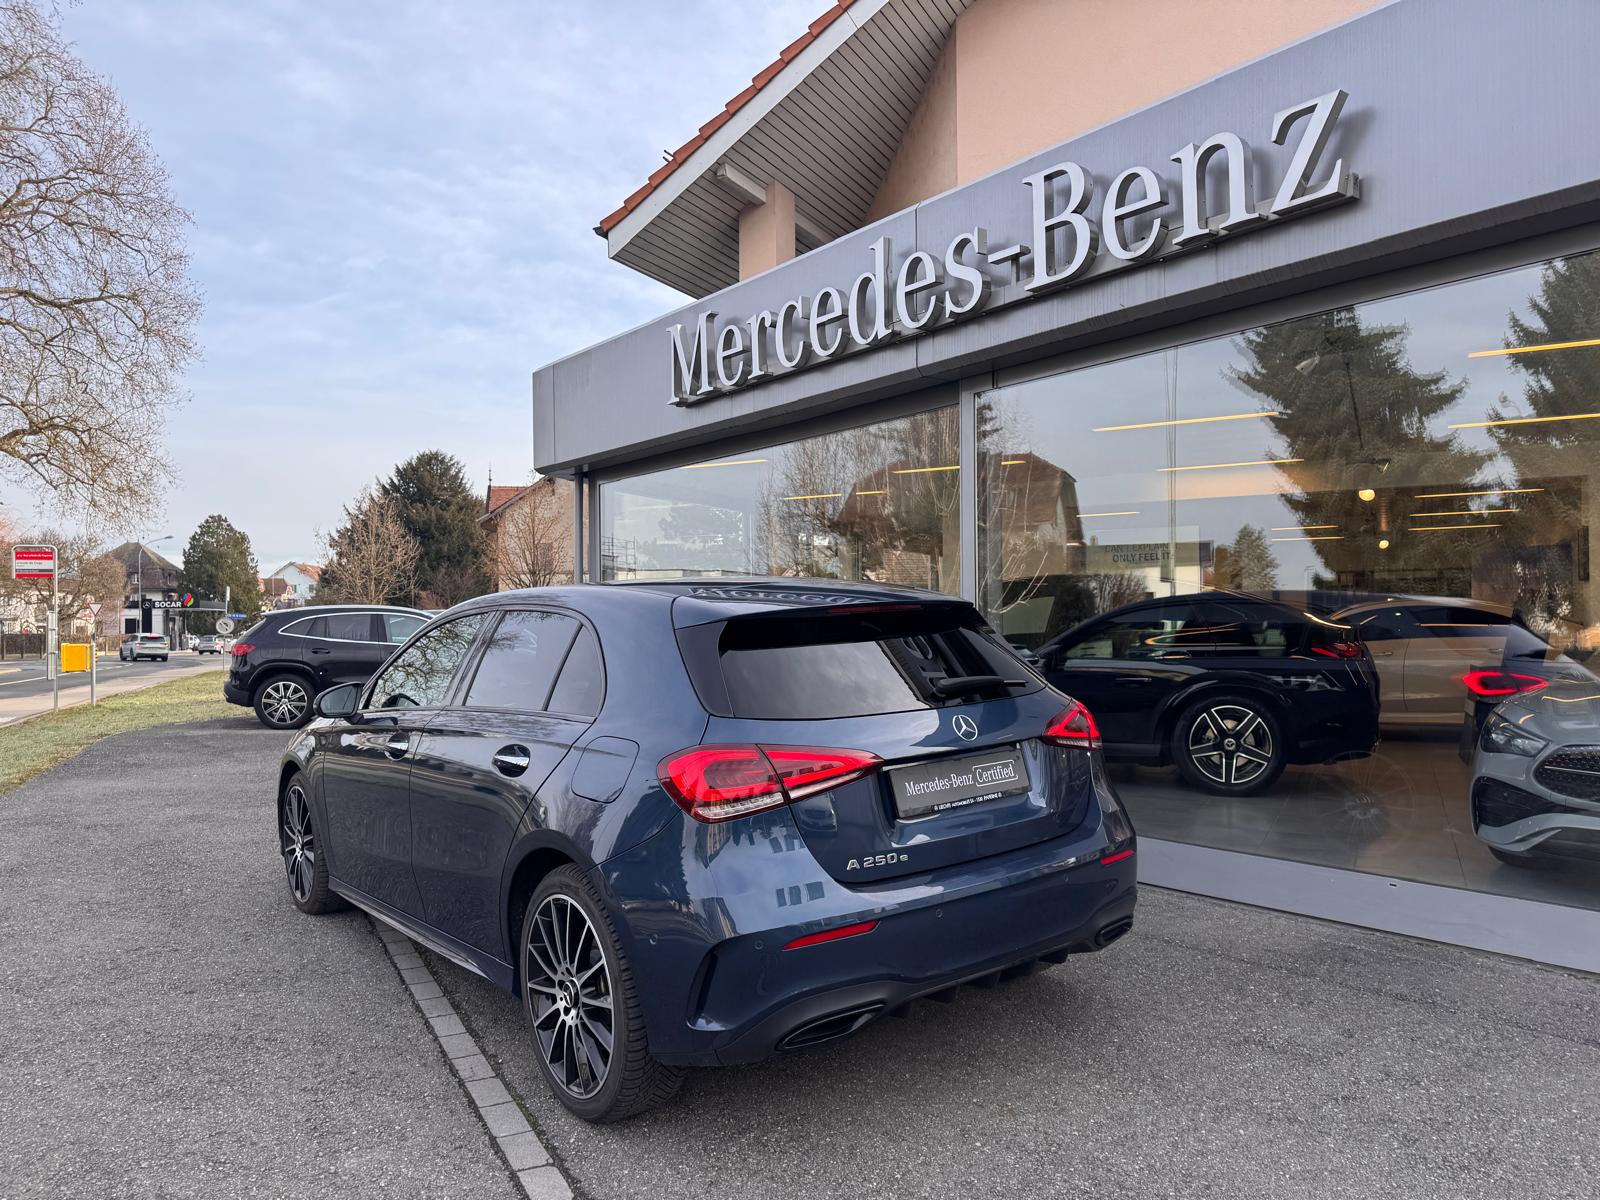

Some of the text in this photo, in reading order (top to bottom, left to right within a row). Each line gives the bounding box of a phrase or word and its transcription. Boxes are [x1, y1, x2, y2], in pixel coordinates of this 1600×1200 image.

[666, 88, 1361, 408] Mercedes-Benz
[1112, 552, 1136, 563] ONLY
[1138, 552, 1160, 562] FEEL
[904, 763, 1015, 796] Mercedes-Benz Certified
[846, 859, 861, 871] A
[863, 852, 897, 868] 250
